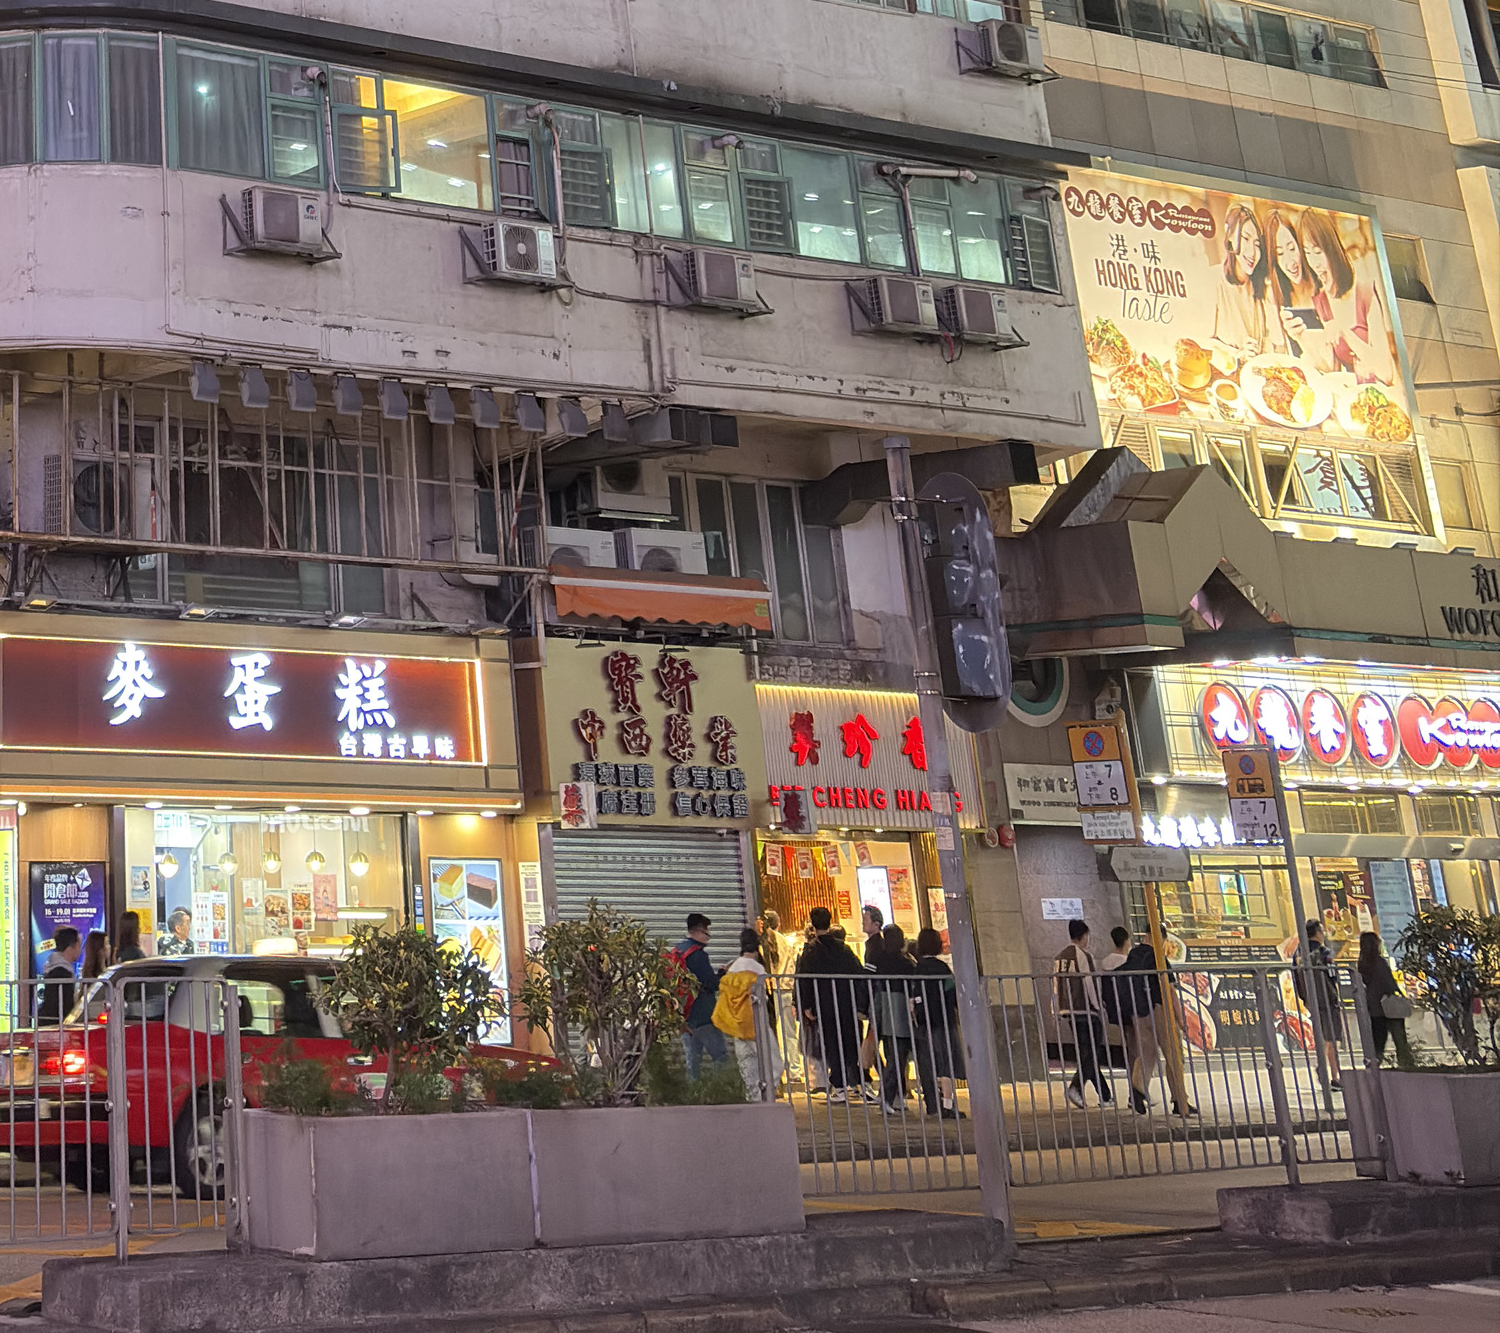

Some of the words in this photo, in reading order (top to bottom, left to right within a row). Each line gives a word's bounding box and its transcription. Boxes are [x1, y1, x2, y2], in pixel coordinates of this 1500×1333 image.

[1067, 191, 1143, 224] 九龍餐室
[1150, 208, 1213, 232] Kowloon
[1095, 258, 1140, 291] HONG
[1143, 265, 1188, 298] KONG
[1116, 285, 1174, 324] Taste
[102, 641, 396, 733] 麥蛋糕
[339, 731, 456, 760] 台灣古早味
[1104, 764, 1112, 779] 7
[812, 785, 888, 810] CHENG
[1109, 787, 1119, 801] 8
[1259, 801, 1267, 814] 7
[1264, 823, 1279, 837] 12
